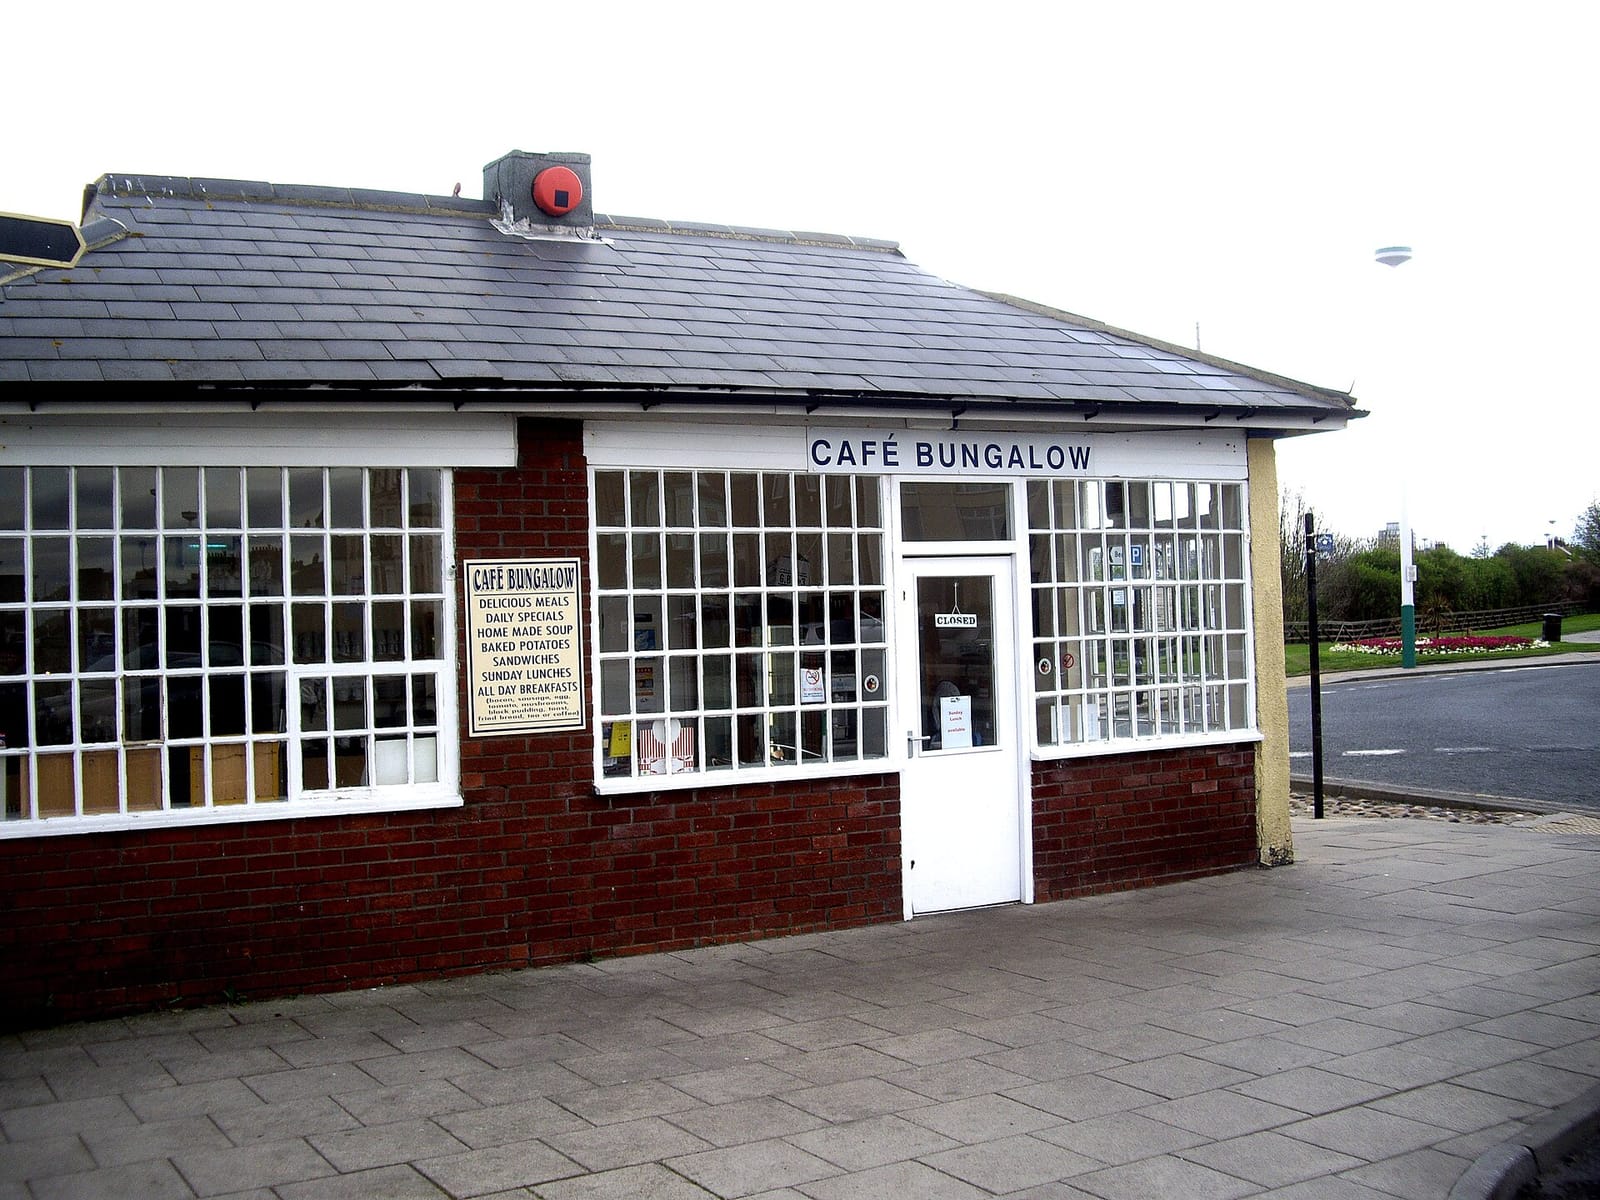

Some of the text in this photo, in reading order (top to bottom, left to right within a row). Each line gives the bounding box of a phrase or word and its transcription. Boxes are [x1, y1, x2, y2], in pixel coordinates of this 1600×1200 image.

[811, 433, 1091, 470] CAFÉ BUNGALOW
[474, 566, 575, 591] CAFÉ BUNGALOW
[480, 596, 570, 609] DELICIOUS MEALS
[486, 611, 564, 623] DAILY SPECIALS
[937, 616, 976, 625] CLOSED
[477, 624, 573, 638] HOME MADE SOUP
[481, 639, 570, 653] BAKED POTATOES
[493, 654, 560, 667] SANDWICHES
[482, 667, 571, 682] SUNDAY LUNCHES
[478, 681, 578, 697] ALL DAY BREAKFASTS
